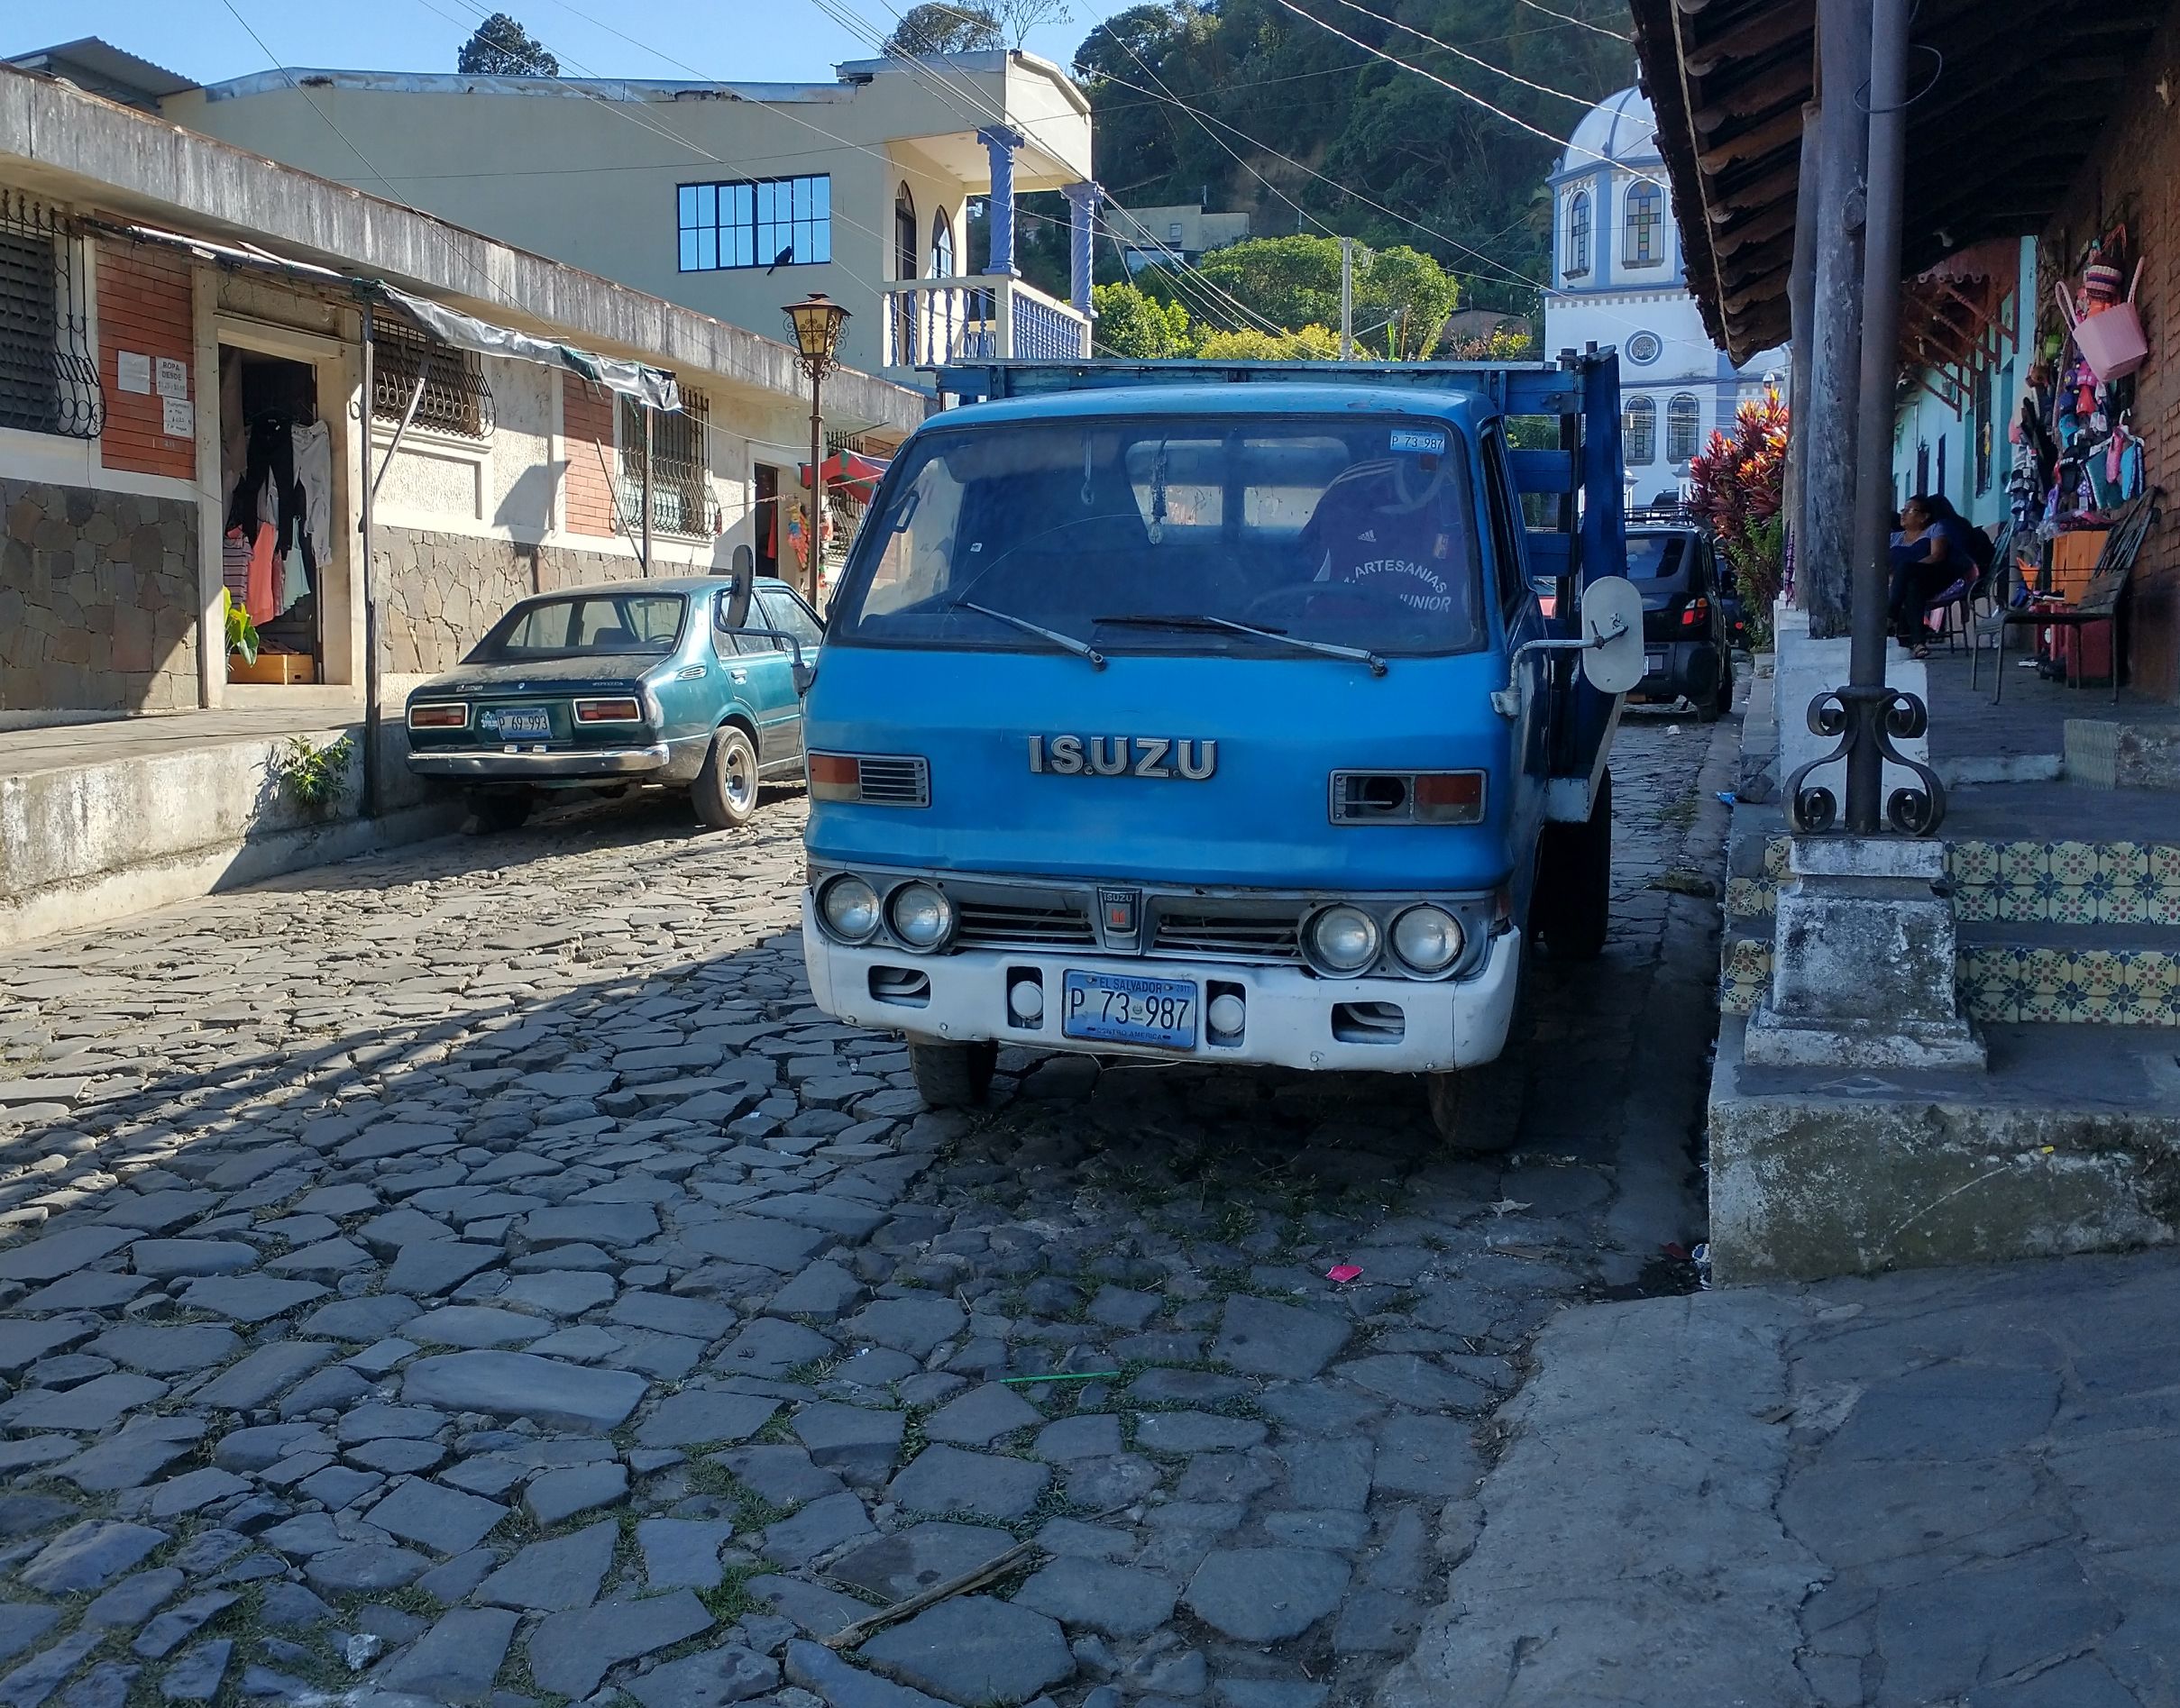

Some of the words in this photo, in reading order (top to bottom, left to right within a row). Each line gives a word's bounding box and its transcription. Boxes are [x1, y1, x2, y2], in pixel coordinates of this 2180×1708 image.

[162, 361, 180, 371] ROPA
[161, 371, 182, 381] DESDE
[1392, 435, 1398, 446] P
[1355, 560, 1447, 593] ARTESANIAS
[499, 716, 505, 731] P
[1029, 735, 1216, 780] ISUZU
[1104, 893, 1133, 902] ISUZU
[1099, 978, 1111, 989] EL
[1113, 979, 1162, 994] SALVADOR
[1070, 987, 1085, 1019] P
[1129, 1030, 1162, 1040] AMERICA
